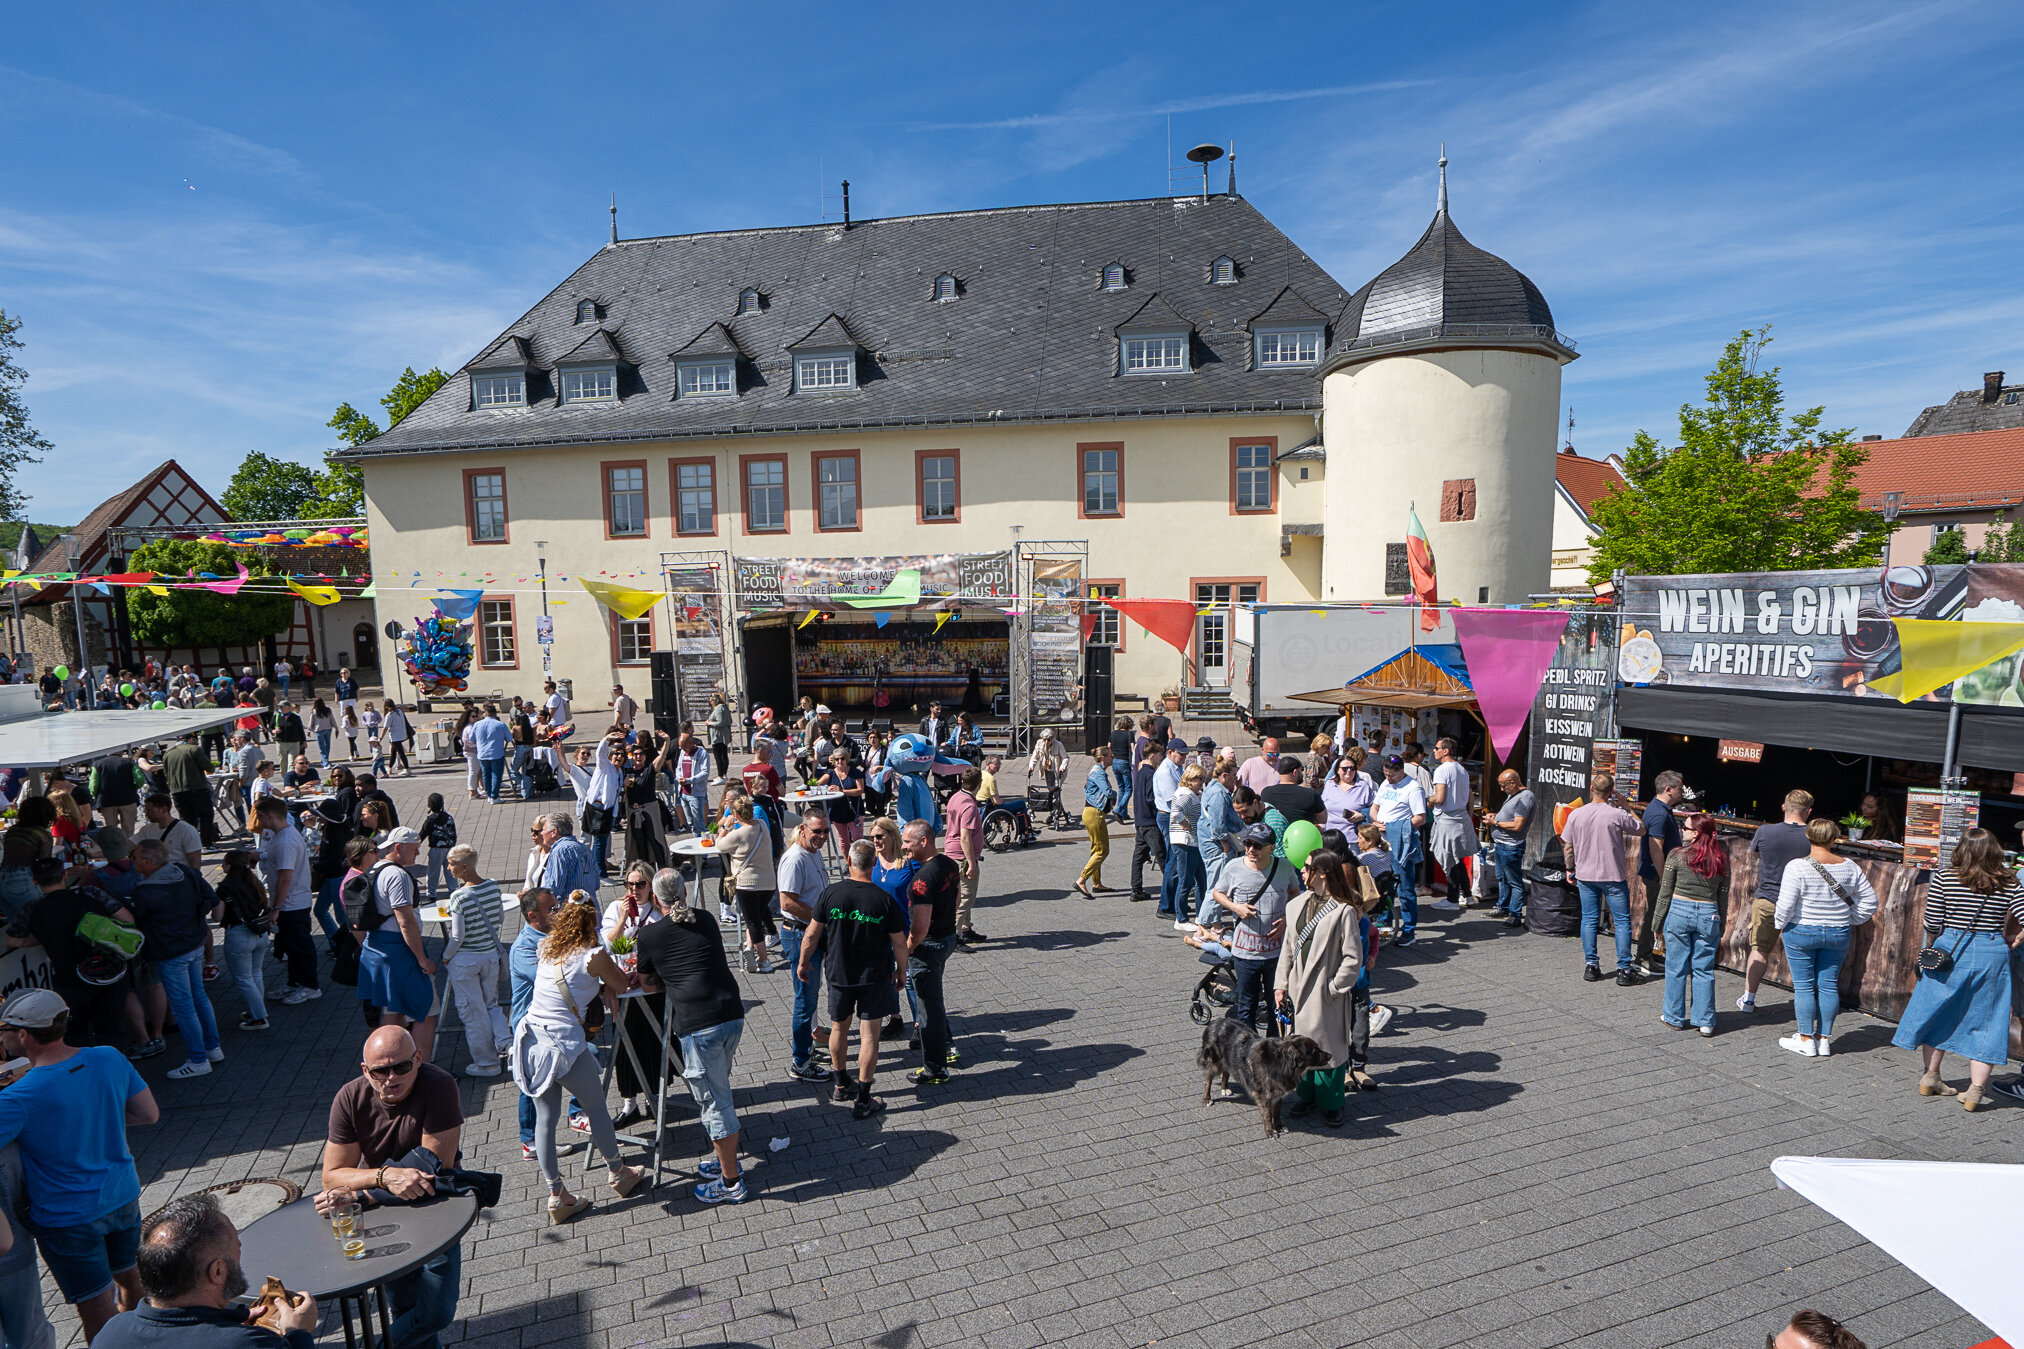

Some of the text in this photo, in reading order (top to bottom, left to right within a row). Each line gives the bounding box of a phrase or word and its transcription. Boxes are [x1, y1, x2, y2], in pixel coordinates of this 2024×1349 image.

[741, 565, 777, 575] STREET
[963, 559, 1004, 571] STREET
[743, 576, 778, 589] FOOD
[839, 570, 895, 581] WELCOME
[965, 571, 1004, 585] FOOD
[744, 590, 780, 602] MUSIC
[792, 586, 805, 595] TO
[808, 586, 826, 595] THE
[829, 585, 860, 595] HOME
[920, 583, 949, 593] MUSIC
[963, 586, 1005, 598] MUSC
[1657, 586, 1861, 636] WEIN & GIN
[1688, 642, 1814, 679] APERITIFS
[1574, 669, 1607, 687] SPRITZ
[1559, 694, 1597, 712] DRINKS
[1543, 744, 1586, 763] ROTWEIN
[1722, 745, 1761, 760] AUSGABE
[1538, 767, 1586, 789] ROSÉWEIN
